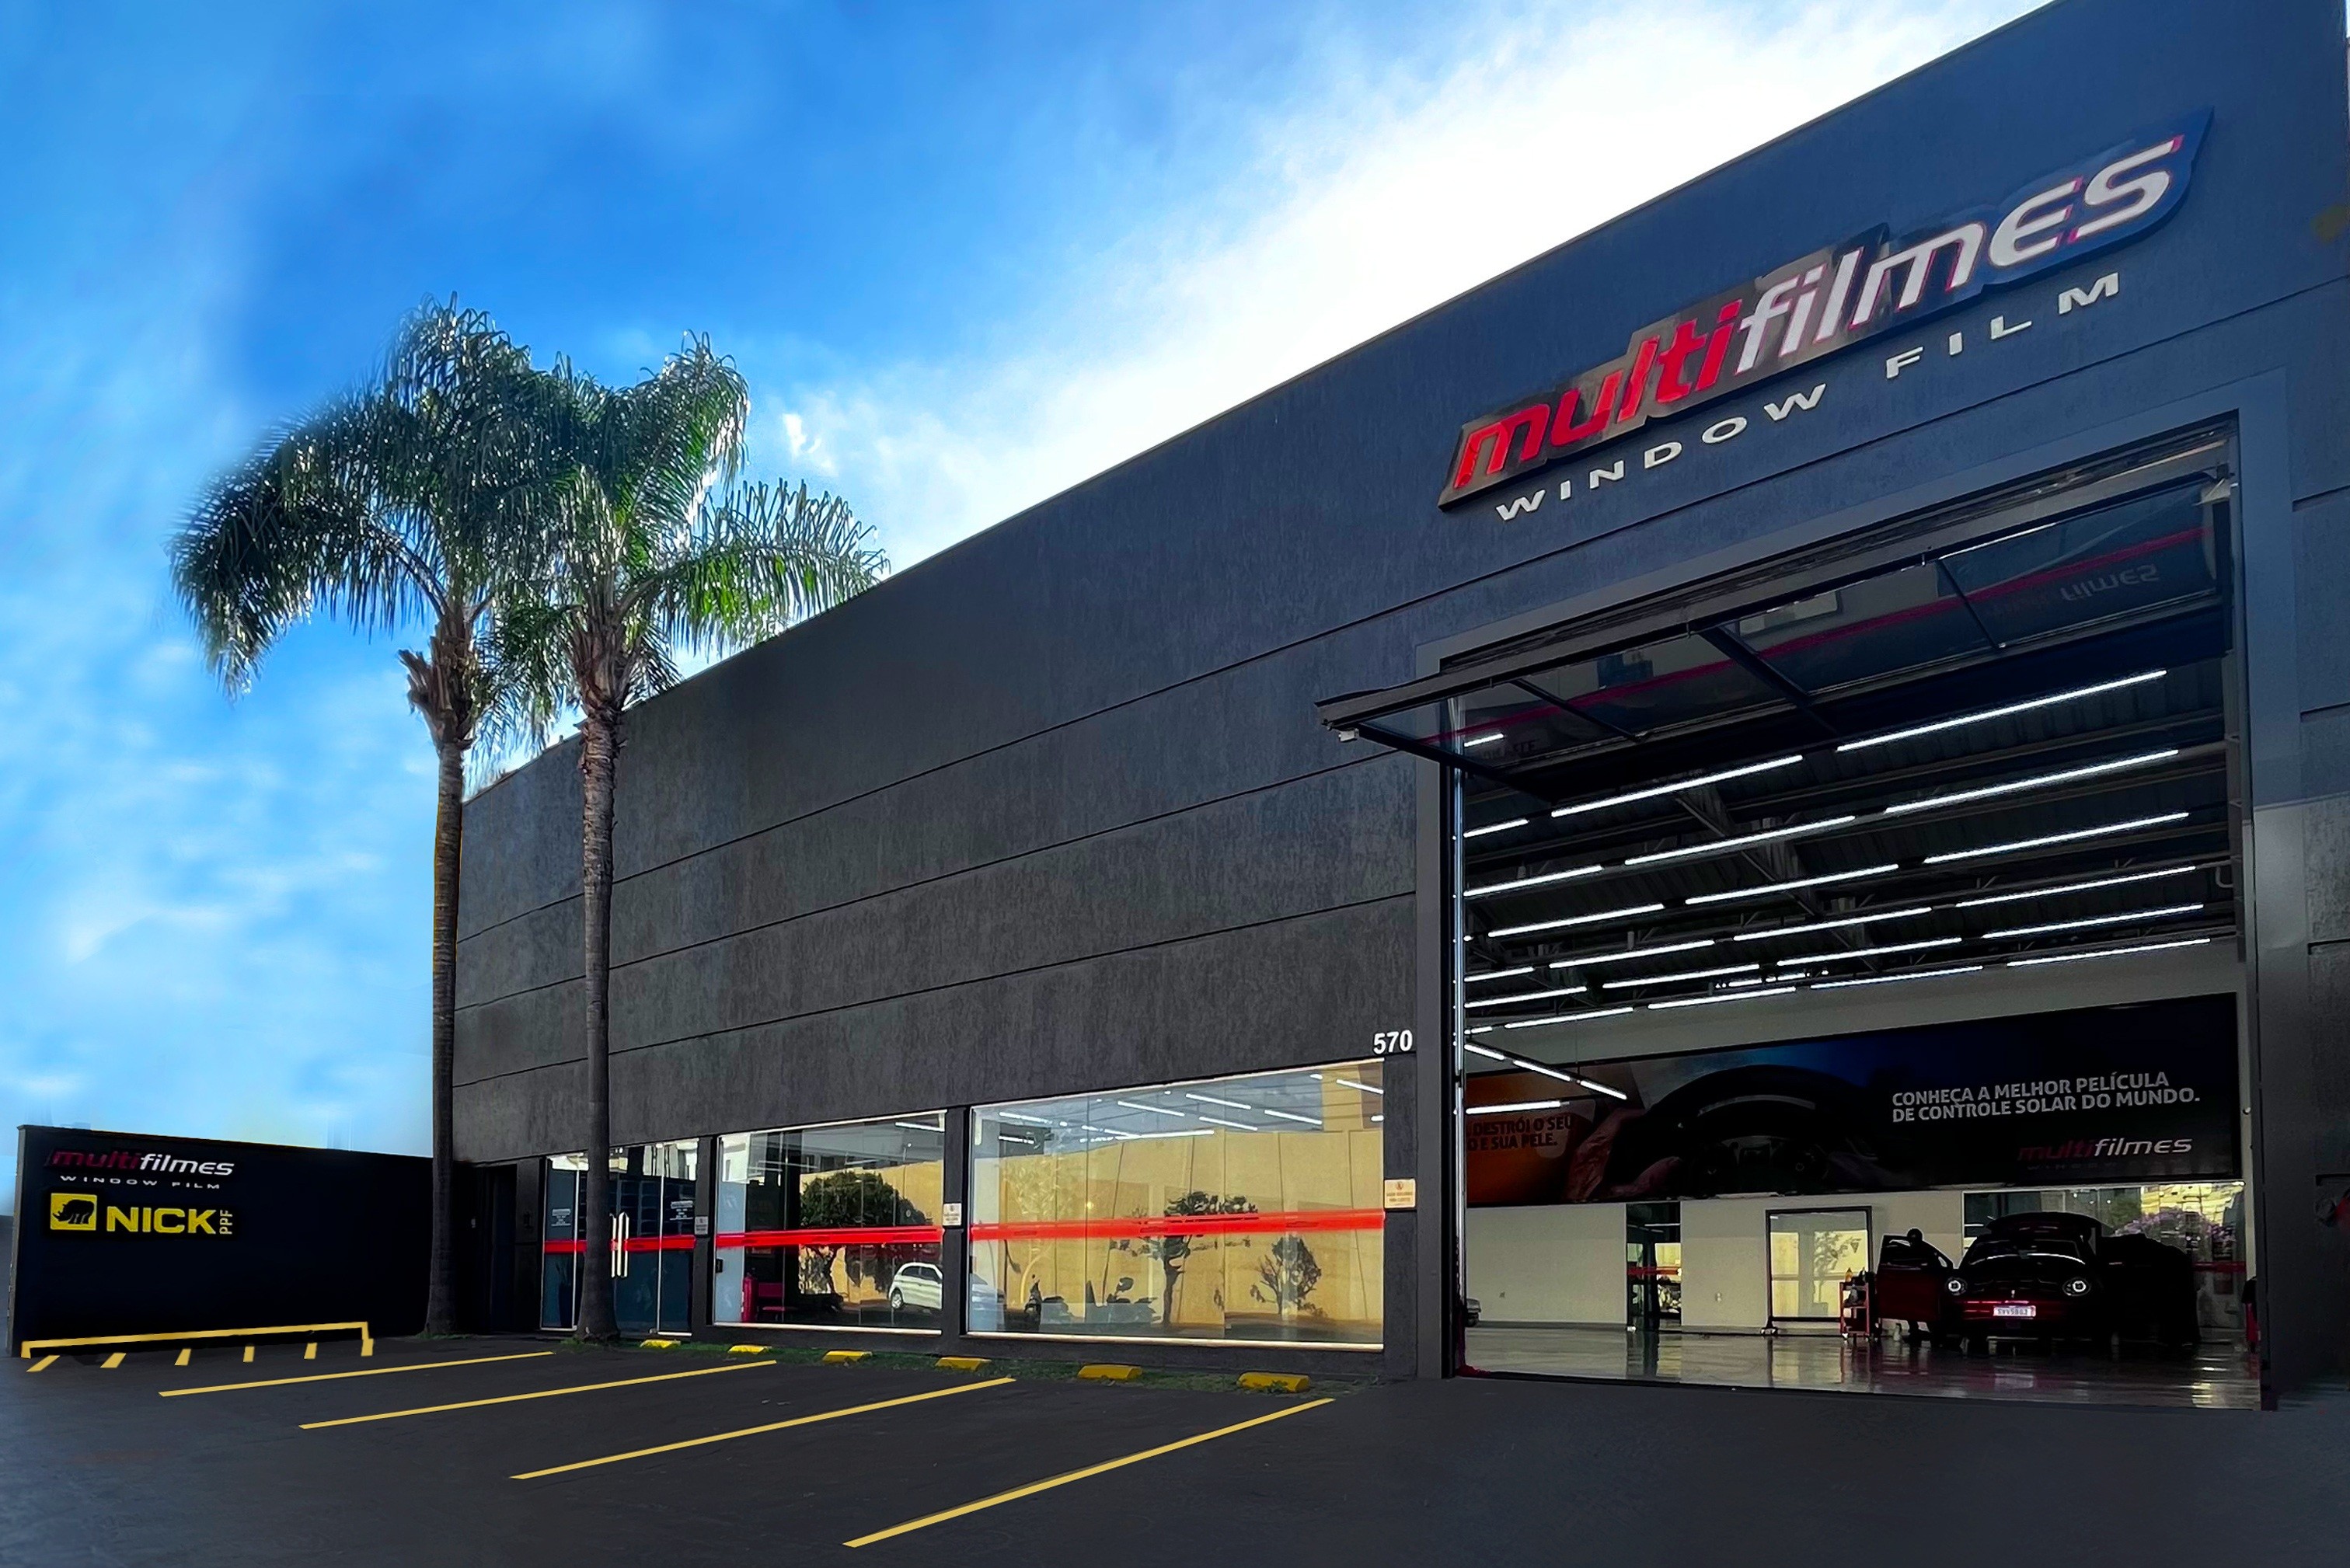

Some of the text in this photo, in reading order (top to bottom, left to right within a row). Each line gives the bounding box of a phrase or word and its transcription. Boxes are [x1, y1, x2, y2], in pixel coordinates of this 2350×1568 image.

[1452, 136, 2181, 490] multifilmes
[1496, 271, 2119, 521] WINDOW FILM
[1373, 1030, 1413, 1054] 570
[1892, 1071, 2169, 1107] CONHEÇA A MELHOR PELÍCULA
[1892, 1087, 2201, 1123] DE CONTROLE SOLAR DO MUNDO.
[1533, 1118, 1545, 1131] O
[1547, 1115, 1573, 1131] SEU
[1480, 1138, 1489, 1151] E
[1491, 1134, 1518, 1150] SUA
[1521, 1133, 1557, 1148] PELE.
[2017, 1137, 2193, 1161] multifilmes
[51, 1150, 235, 1176] multifilmes
[60, 1175, 221, 1190] WINDOW FILM
[106, 1205, 233, 1235] NICK PPF
